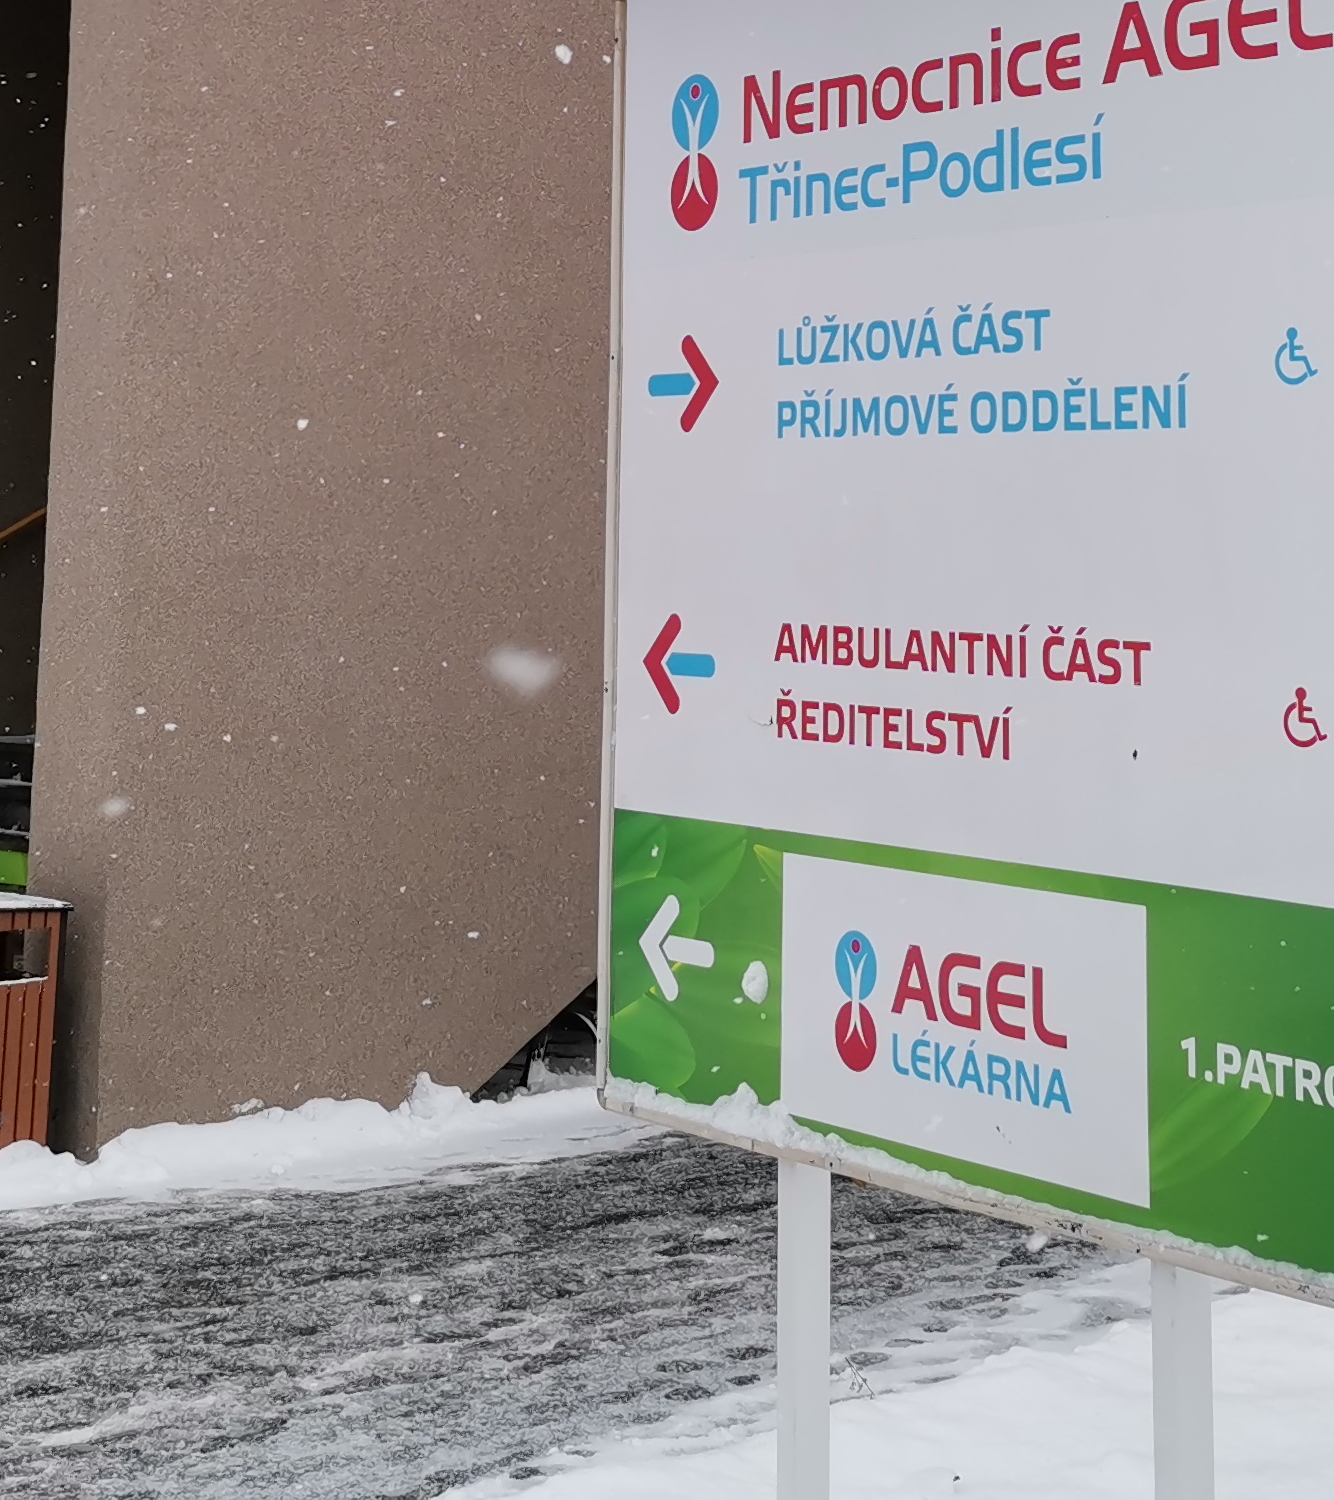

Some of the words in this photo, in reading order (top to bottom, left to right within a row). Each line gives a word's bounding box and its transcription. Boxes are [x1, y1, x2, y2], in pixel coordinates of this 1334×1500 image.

[742, 27, 1082, 145] Nemocnice
[737, 112, 1105, 225] Třinec-Podlesí
[777, 307, 943, 368] LŮŽKOVÁ
[951, 302, 1052, 358] ČÁST
[776, 382, 960, 440] PŘÍJMOVÉ
[969, 372, 1191, 436] ODDĚLENÍ
[773, 621, 1031, 679] AMBULANTNÍ
[1041, 623, 1153, 687] ČÁST
[775, 688, 1014, 762] ŘEDITELSTVÍ
[890, 944, 1069, 1050] AGEL
[891, 1029, 1073, 1115] LÉKÁRNA
